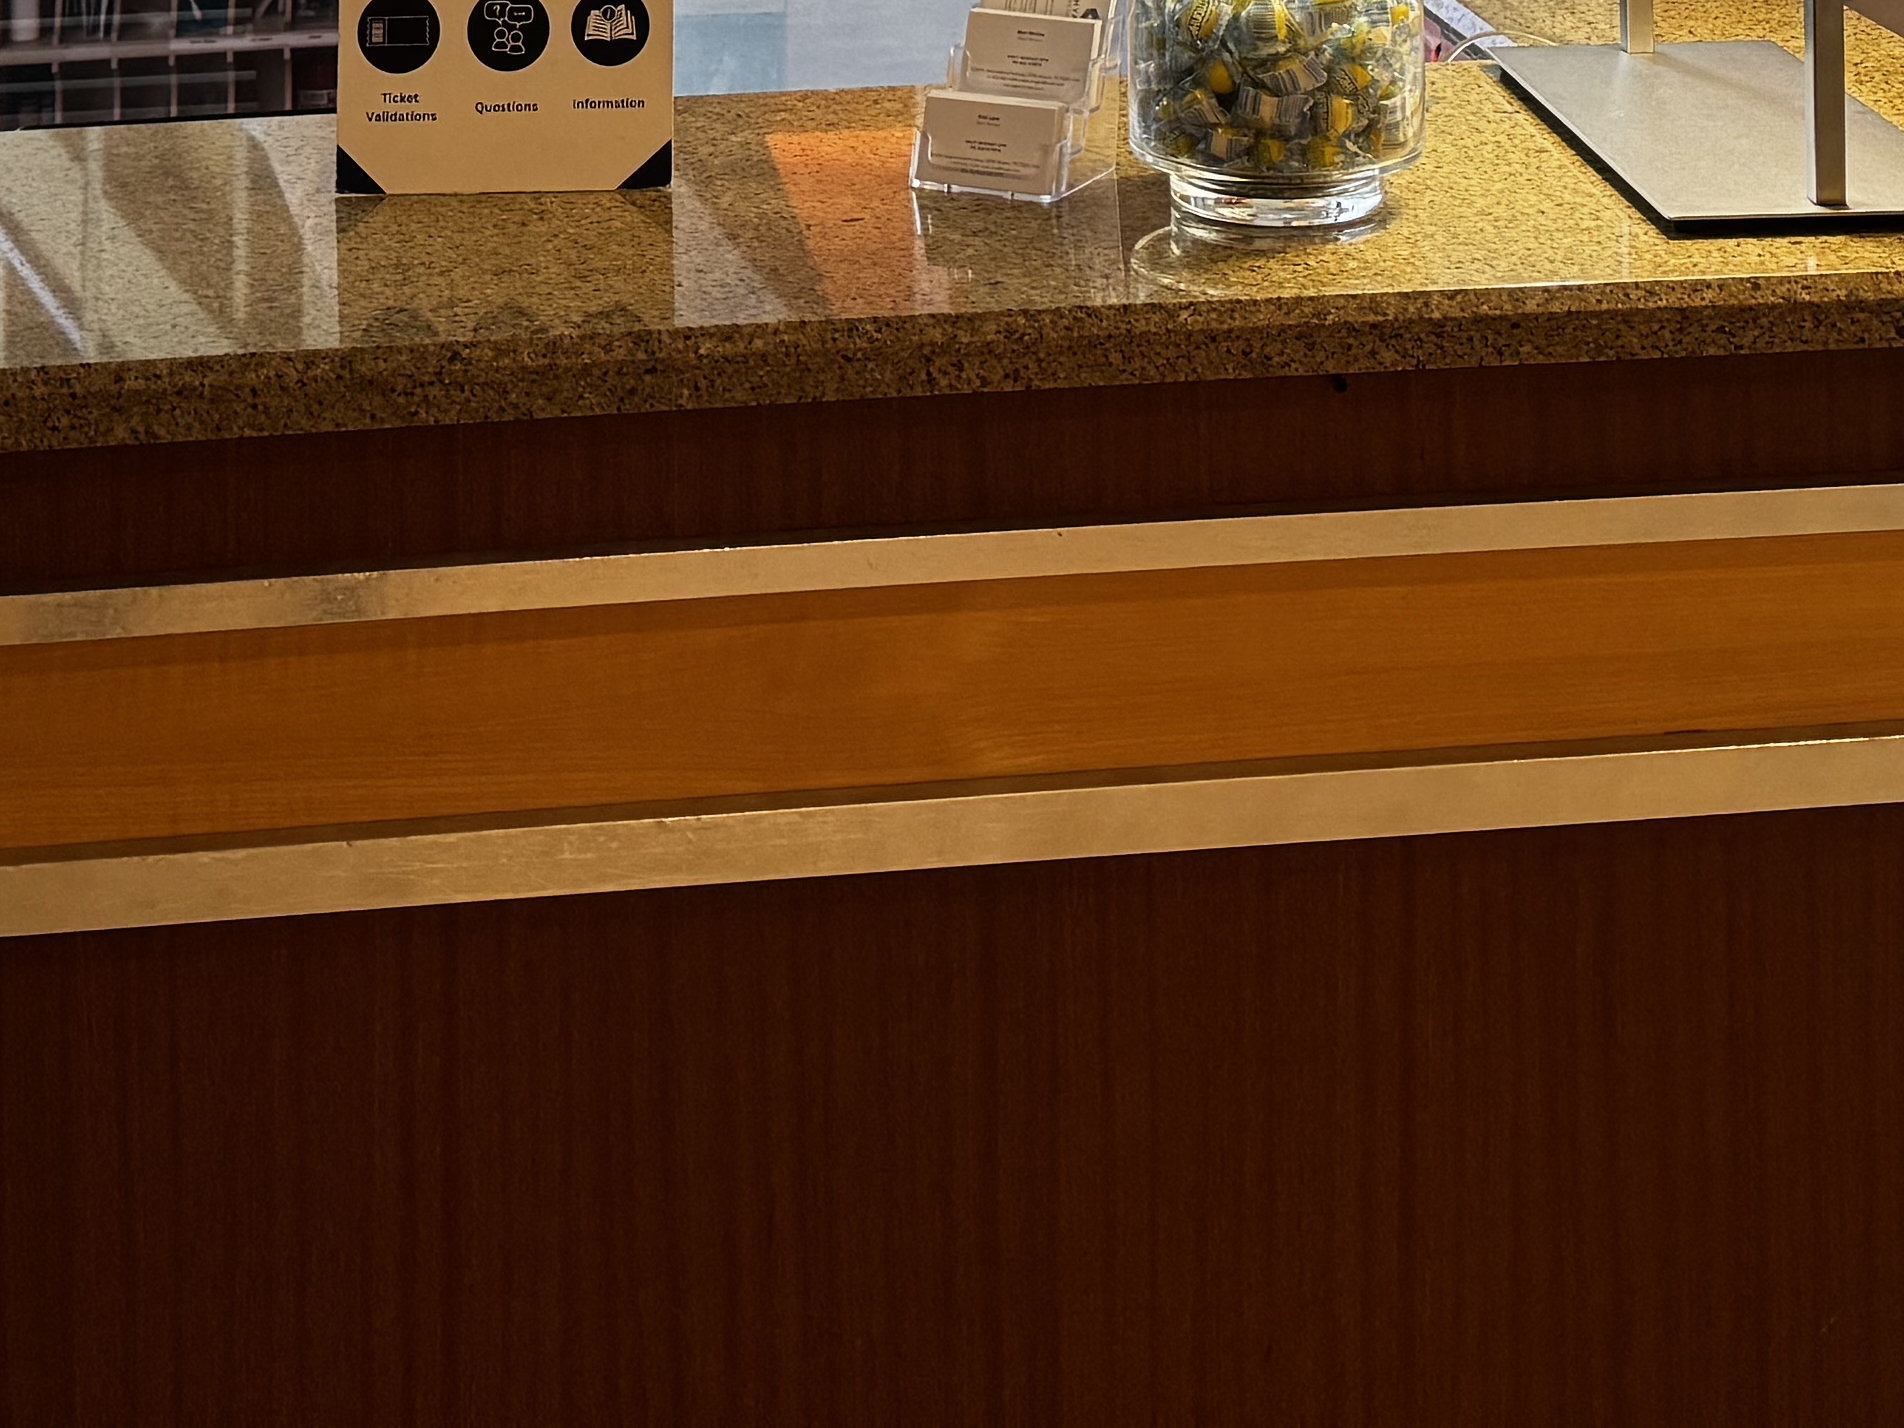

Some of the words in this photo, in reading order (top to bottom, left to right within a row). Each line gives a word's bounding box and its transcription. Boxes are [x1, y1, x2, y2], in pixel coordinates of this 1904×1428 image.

[381, 92, 420, 104] Ticket
[572, 97, 645, 110] Information
[475, 101, 538, 115] Questions
[365, 111, 438, 123] Validations
